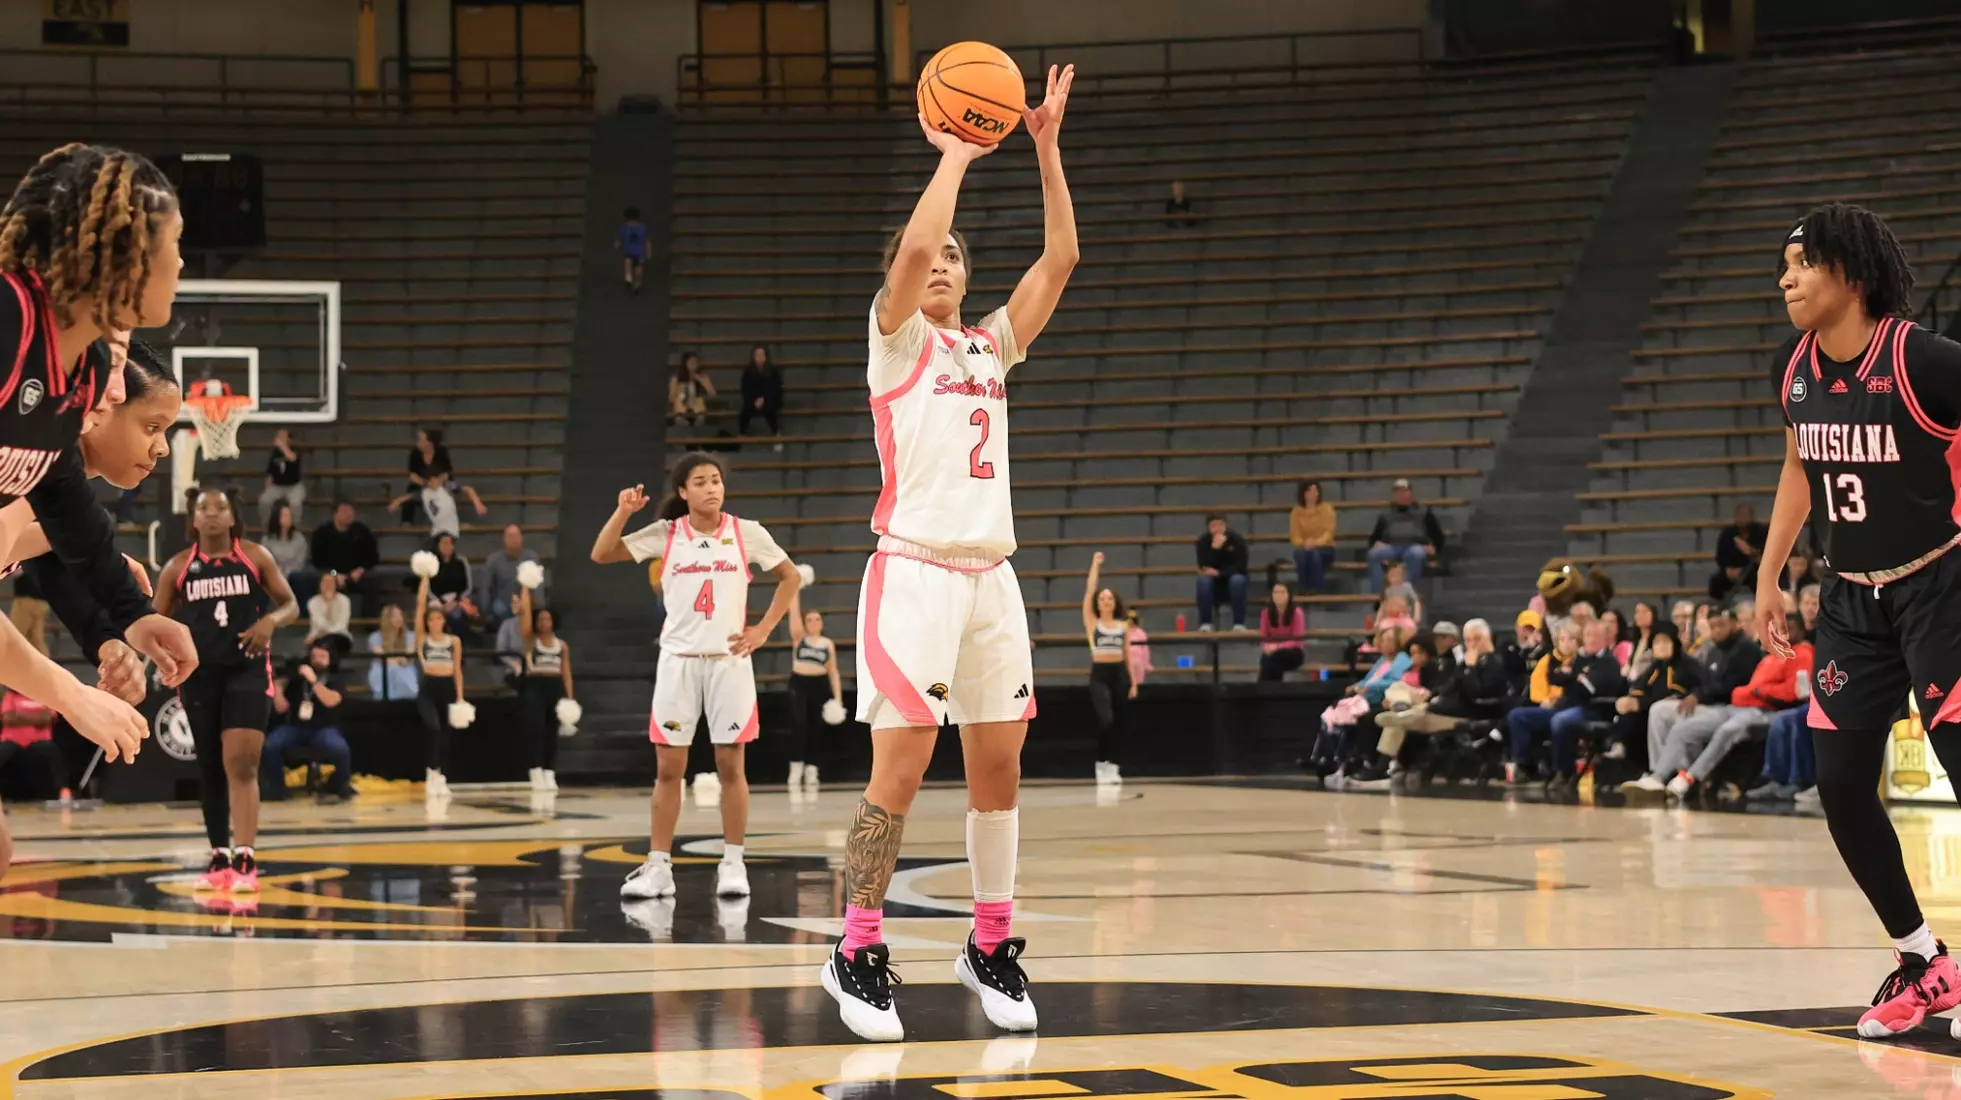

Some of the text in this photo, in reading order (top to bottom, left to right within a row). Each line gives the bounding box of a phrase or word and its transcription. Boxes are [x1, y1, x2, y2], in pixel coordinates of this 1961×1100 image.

[962, 108, 1009, 134] NCAA
[969, 408, 995, 479] 2
[1792, 422, 1901, 462] LOUISIANA
[1823, 473, 1867, 522] 13
[186, 574, 251, 602] LOUISIANA
[693, 579, 715, 620] 4
[213, 600, 229, 628] 4
